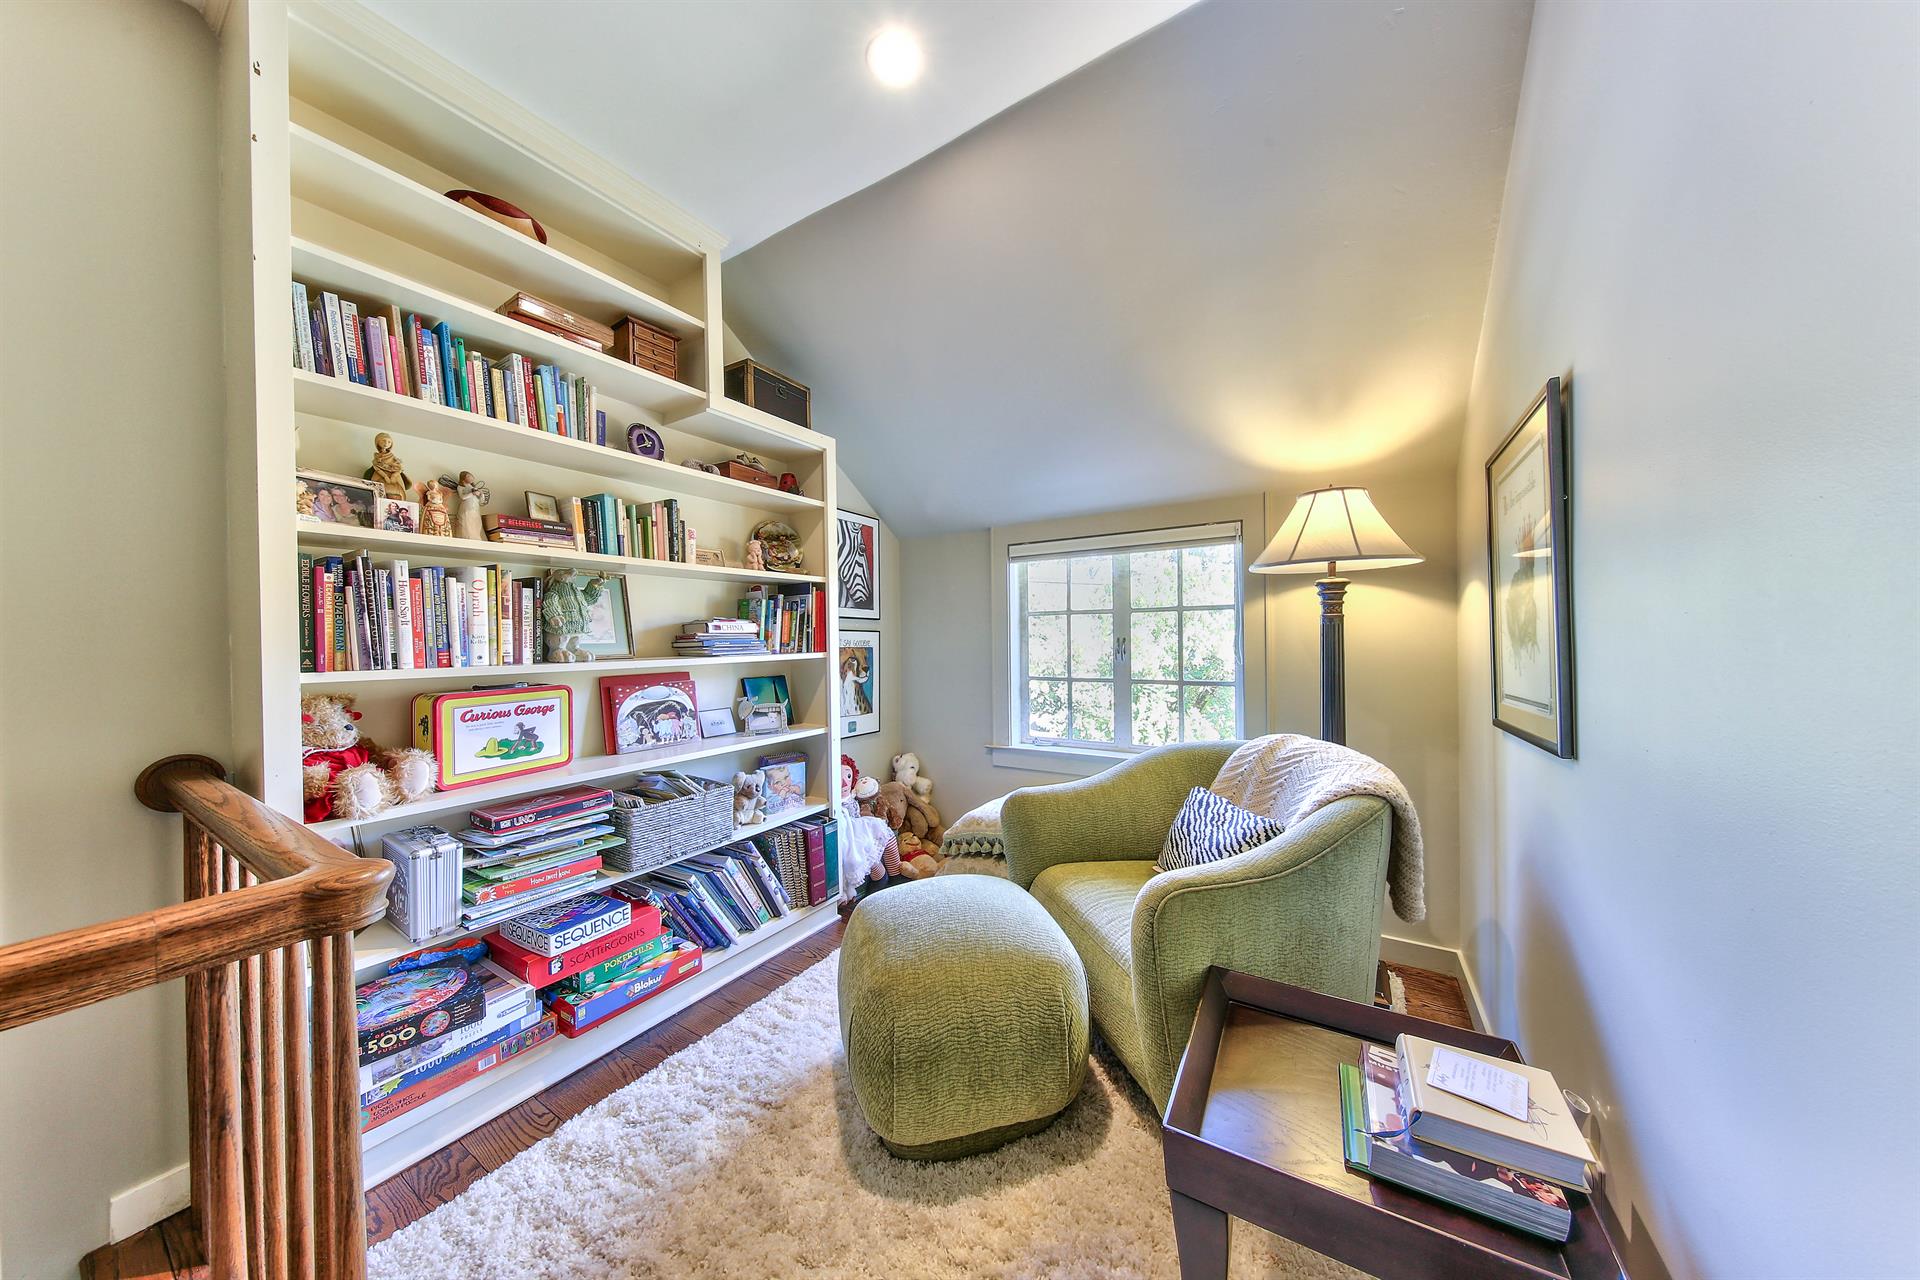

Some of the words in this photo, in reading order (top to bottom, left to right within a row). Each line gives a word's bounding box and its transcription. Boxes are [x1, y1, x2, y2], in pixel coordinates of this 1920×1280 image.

[330, 310, 340, 342] Rediscover
[345, 323, 353, 334] GIFT
[334, 342, 344, 375] Catholicism
[477, 384, 485, 413] MIRACLES
[508, 520, 543, 528] RELENTLESS
[301, 559, 310, 583] EDIBLE
[365, 570, 376, 620] DIMAGGIO
[398, 580, 408, 597] How
[468, 579, 485, 617] Oprah
[302, 584, 310, 618] FLOWERS
[334, 596, 343, 618] SUZE
[398, 606, 409, 619] Say
[336, 619, 344, 650] ORMAN
[460, 708, 511, 723] Curious
[514, 703, 555, 716] George
[514, 814, 536, 826] UNO
[530, 876, 545, 886] Home
[546, 871, 558, 880] sweet
[559, 869, 571, 879] home
[508, 922, 549, 952] SEQUENCE
[554, 907, 630, 950] SEQUENCE
[604, 951, 632, 972] POKER
[632, 942, 655, 956] TILES
[633, 973, 663, 993] Blokus
[367, 1026, 416, 1054] 500
[377, 1040, 408, 1055] PUZZLE
[471, 1037, 488, 1048] Puzzle
[1369, 1060, 1397, 1072] MUST
